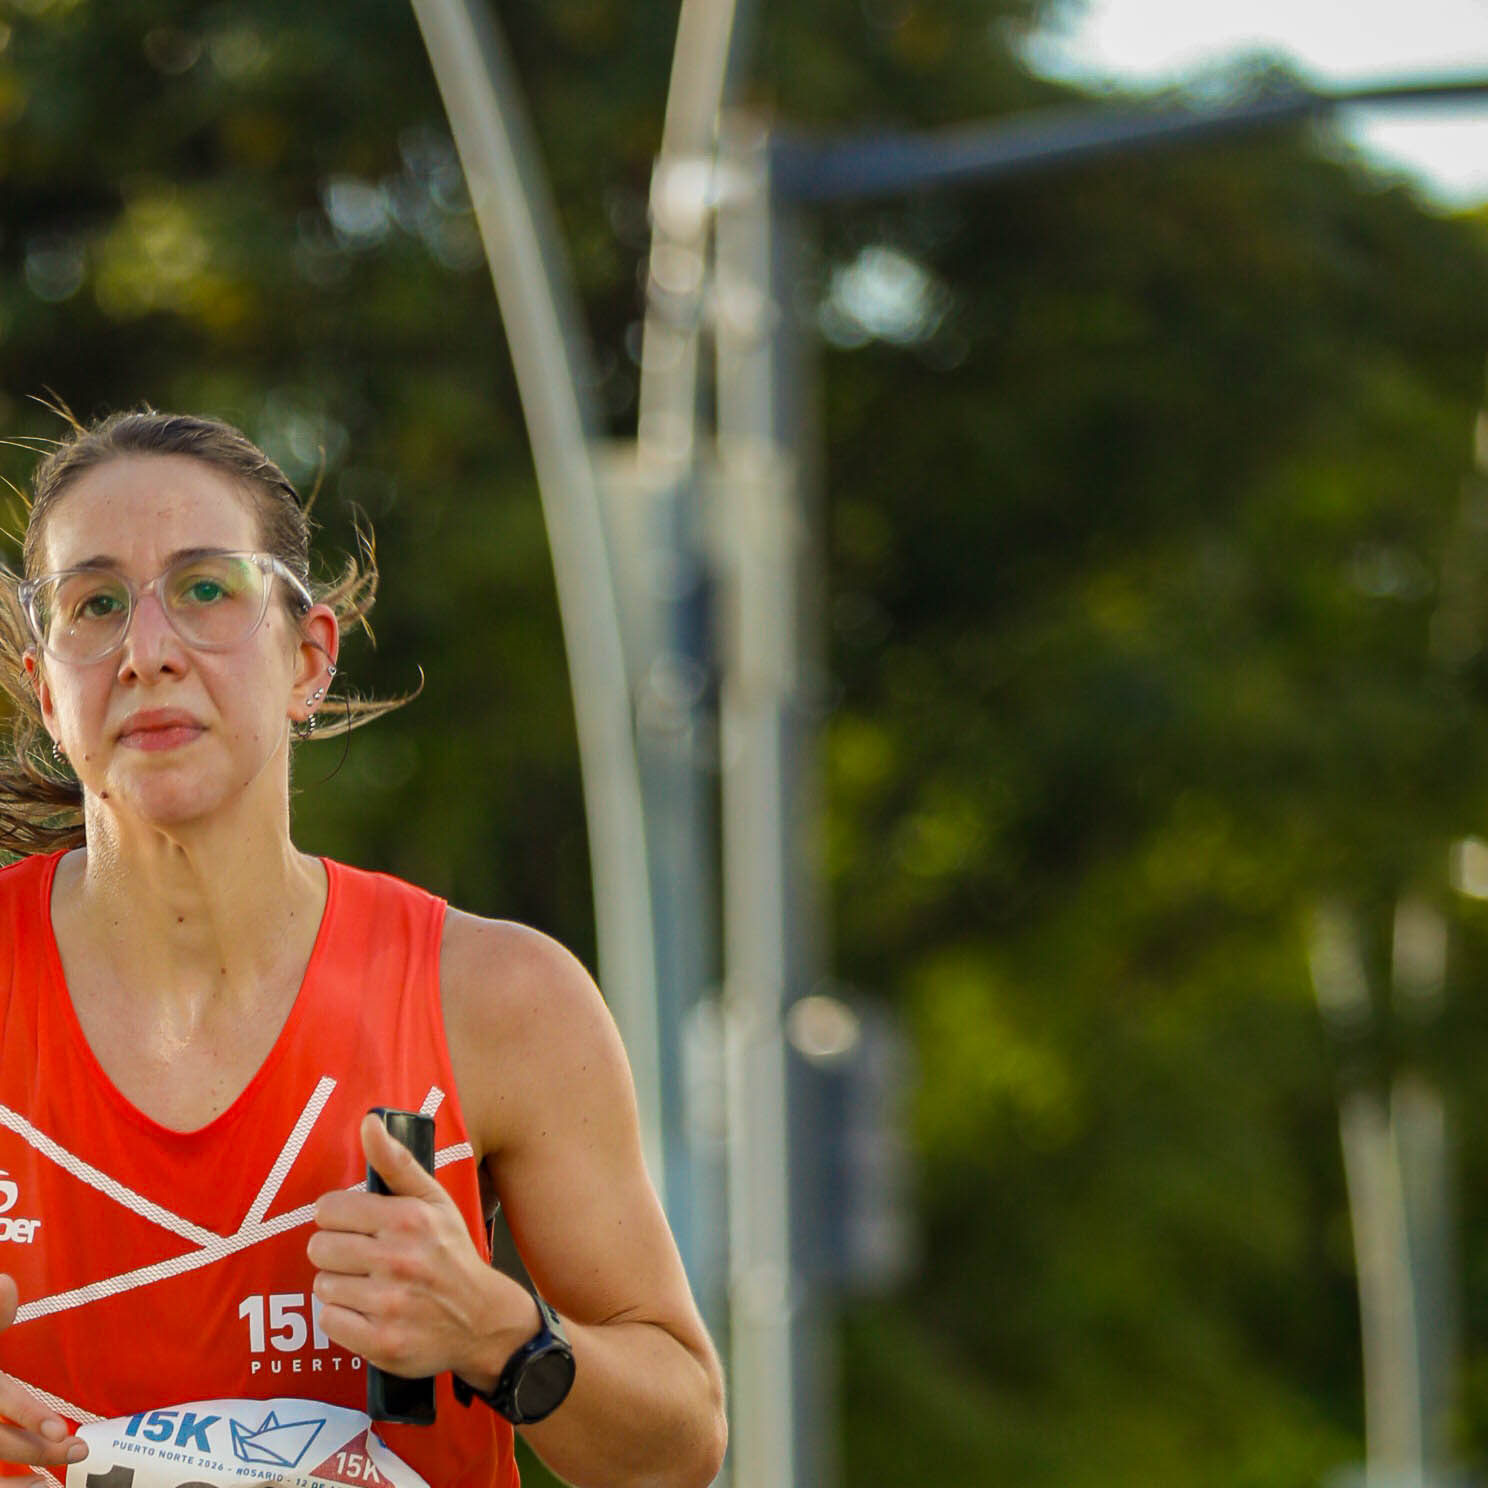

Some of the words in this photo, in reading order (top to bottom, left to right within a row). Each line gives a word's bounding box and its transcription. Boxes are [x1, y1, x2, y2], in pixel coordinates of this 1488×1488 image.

[251, 1357, 361, 1375] PUERTO
[125, 1411, 222, 1453] 15K
[112, 1440, 155, 1456] PUERTO
[158, 1449, 194, 1465] NORTE
[198, 1459, 224, 1472] 2026
[296, 1477, 308, 1488] 12
